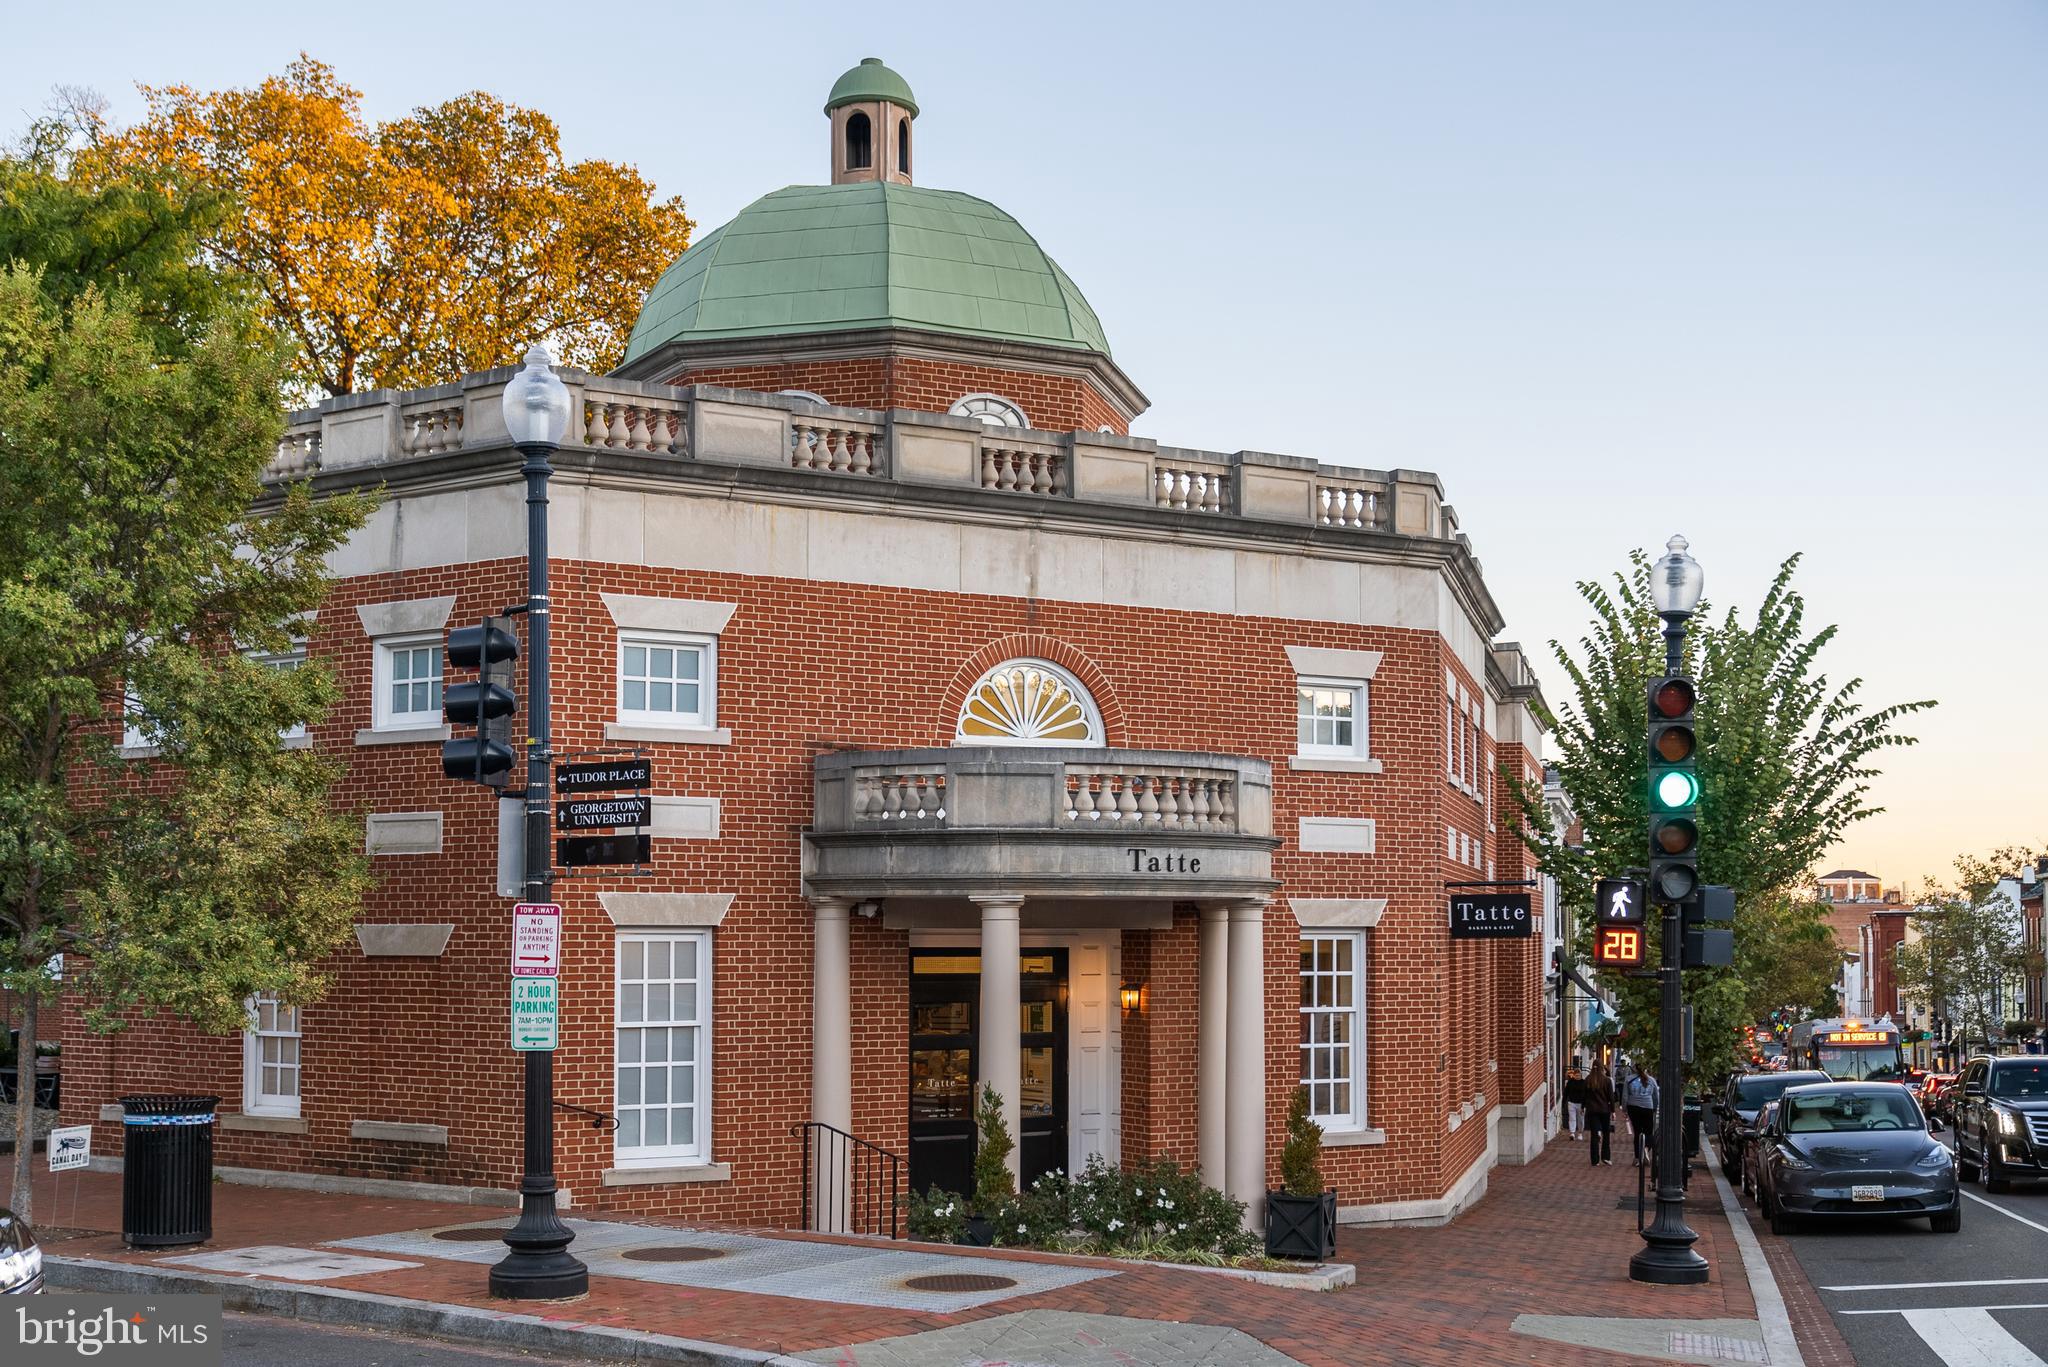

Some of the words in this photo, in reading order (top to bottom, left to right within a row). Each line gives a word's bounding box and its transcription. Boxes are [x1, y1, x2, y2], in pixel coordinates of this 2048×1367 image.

[569, 771, 607, 784] TUDOR
[609, 769, 646, 781] PLACE
[570, 800, 646, 814] GEORGETOWN
[574, 812, 642, 826] UNIVERSITY
[1127, 848, 1201, 874] Tatte
[1457, 902, 1525, 922] Tatte
[531, 918, 543, 926] NO
[519, 926, 554, 935] STANDING
[522, 943, 550, 952] ANYTIME
[1603, 931, 1637, 960] 28
[518, 985, 524, 998] 2
[527, 985, 551, 998] HOUR
[514, 1001, 555, 1014] PARKING
[518, 1016, 553, 1025] 7AM-10PM
[1829, 1033, 1841, 1042] NOT
[1842, 1033, 1851, 1042] IN
[1851, 1032, 1877, 1042] SERVICE
[927, 1078, 956, 1088] Tatte
[51, 1155, 70, 1165] CANAL
[71, 1153, 82, 1162] DAY
